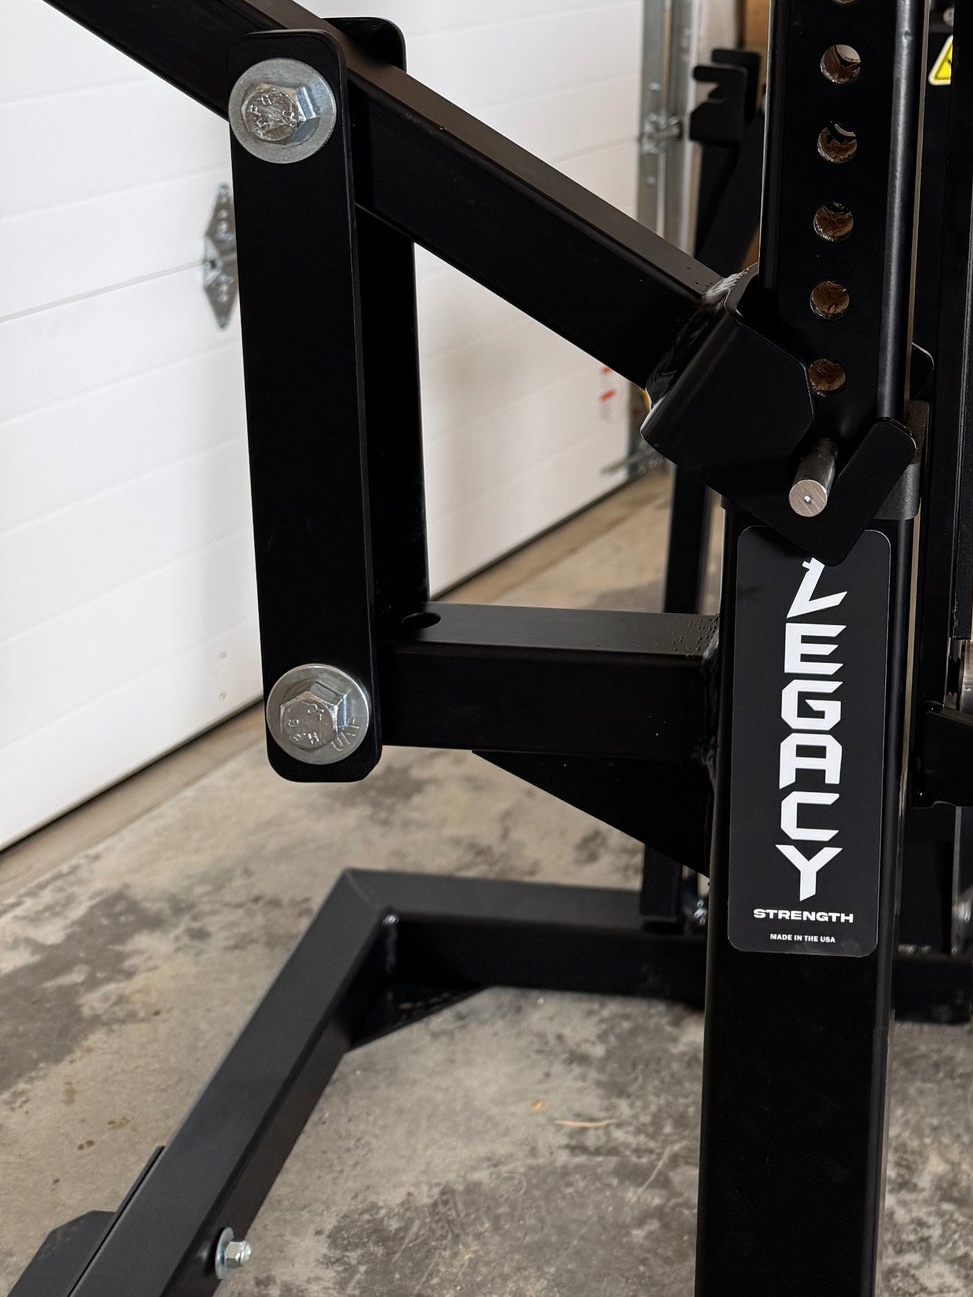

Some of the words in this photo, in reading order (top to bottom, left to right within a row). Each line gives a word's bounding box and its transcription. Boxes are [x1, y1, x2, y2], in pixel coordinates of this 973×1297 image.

[775, 557, 849, 902] LEGACY
[753, 908, 854, 923] STRENGTH
[770, 933, 793, 941] MADE
[820, 935, 836, 943] USA
